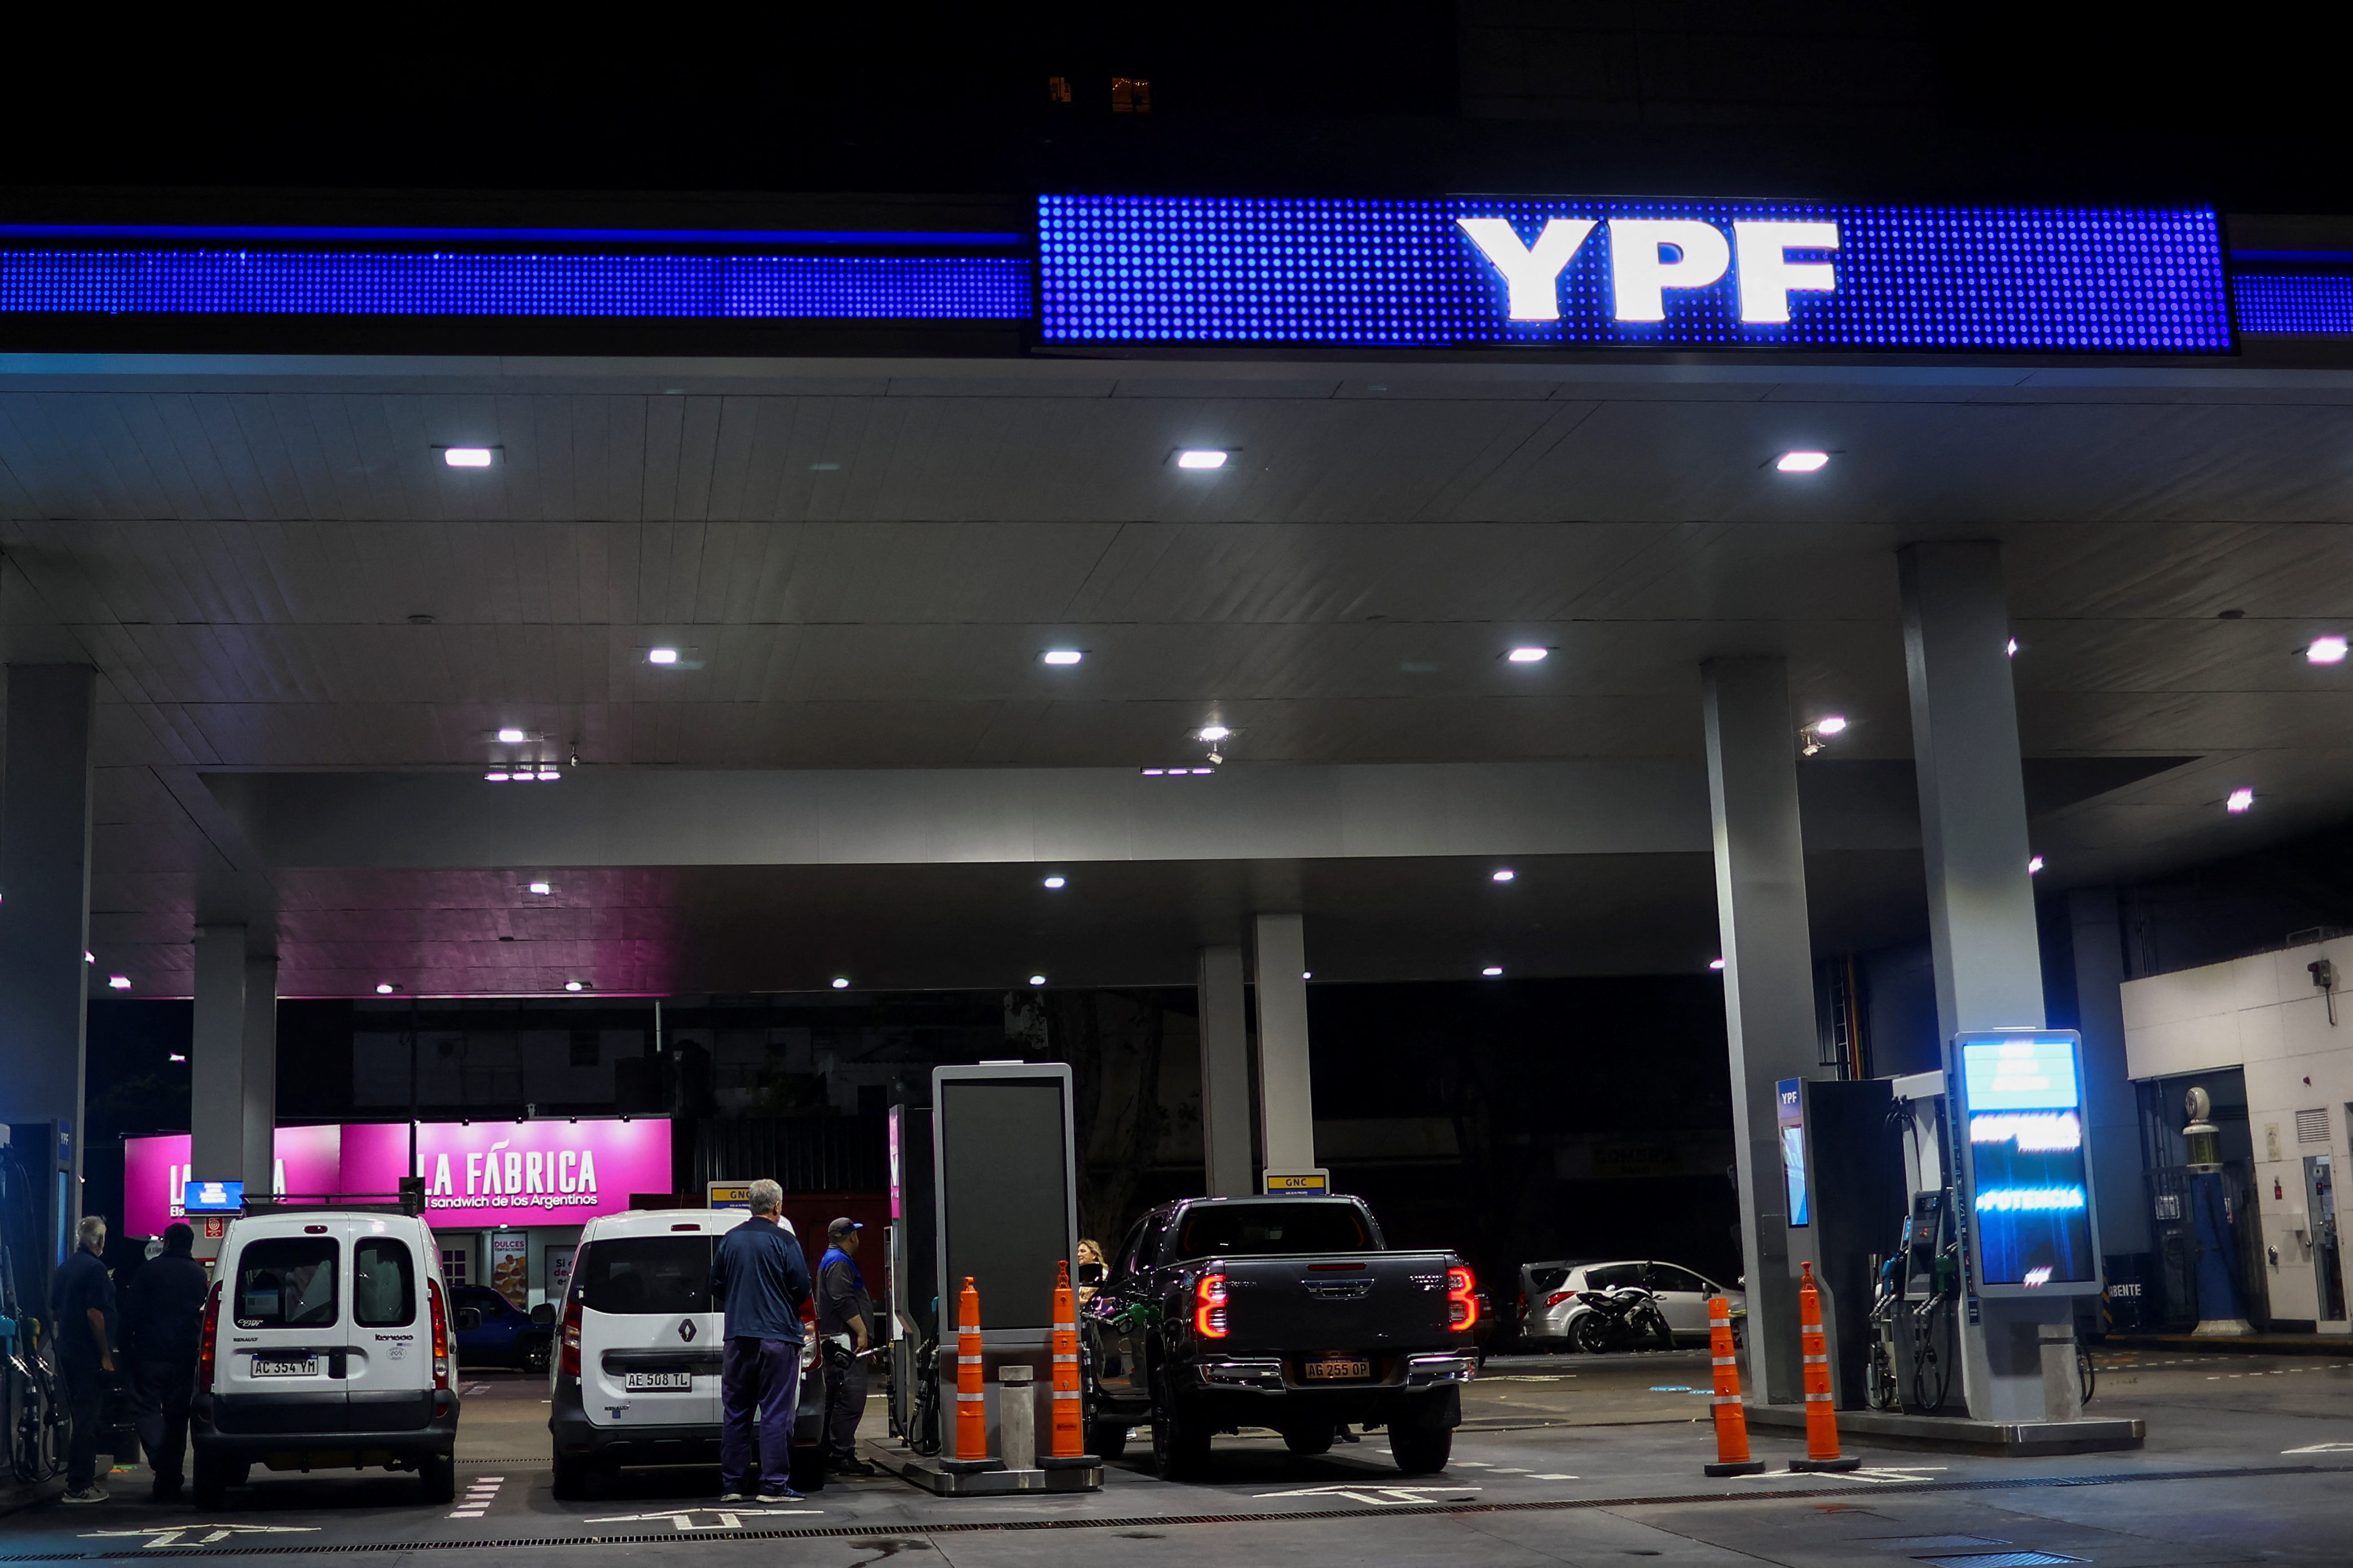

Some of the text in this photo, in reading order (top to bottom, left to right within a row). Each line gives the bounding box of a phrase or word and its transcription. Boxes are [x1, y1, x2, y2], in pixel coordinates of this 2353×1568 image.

[1455, 218, 1839, 324] YPF
[1782, 1091, 1797, 1104] YPF
[60, 1132, 69, 1145] YPF
[417, 1138, 597, 1195] LA FÁBRICA
[431, 1195, 489, 1208] sandwich
[492, 1195, 508, 1207] de
[511, 1195, 528, 1206] los
[530, 1194, 598, 1209] Argentinos
[556, 1259, 565, 1267] Si
[255, 1361, 315, 1373] AC 354 YM
[1309, 1363, 1367, 1376] AG 255 OP
[628, 1373, 688, 1386] AE 508 TL
